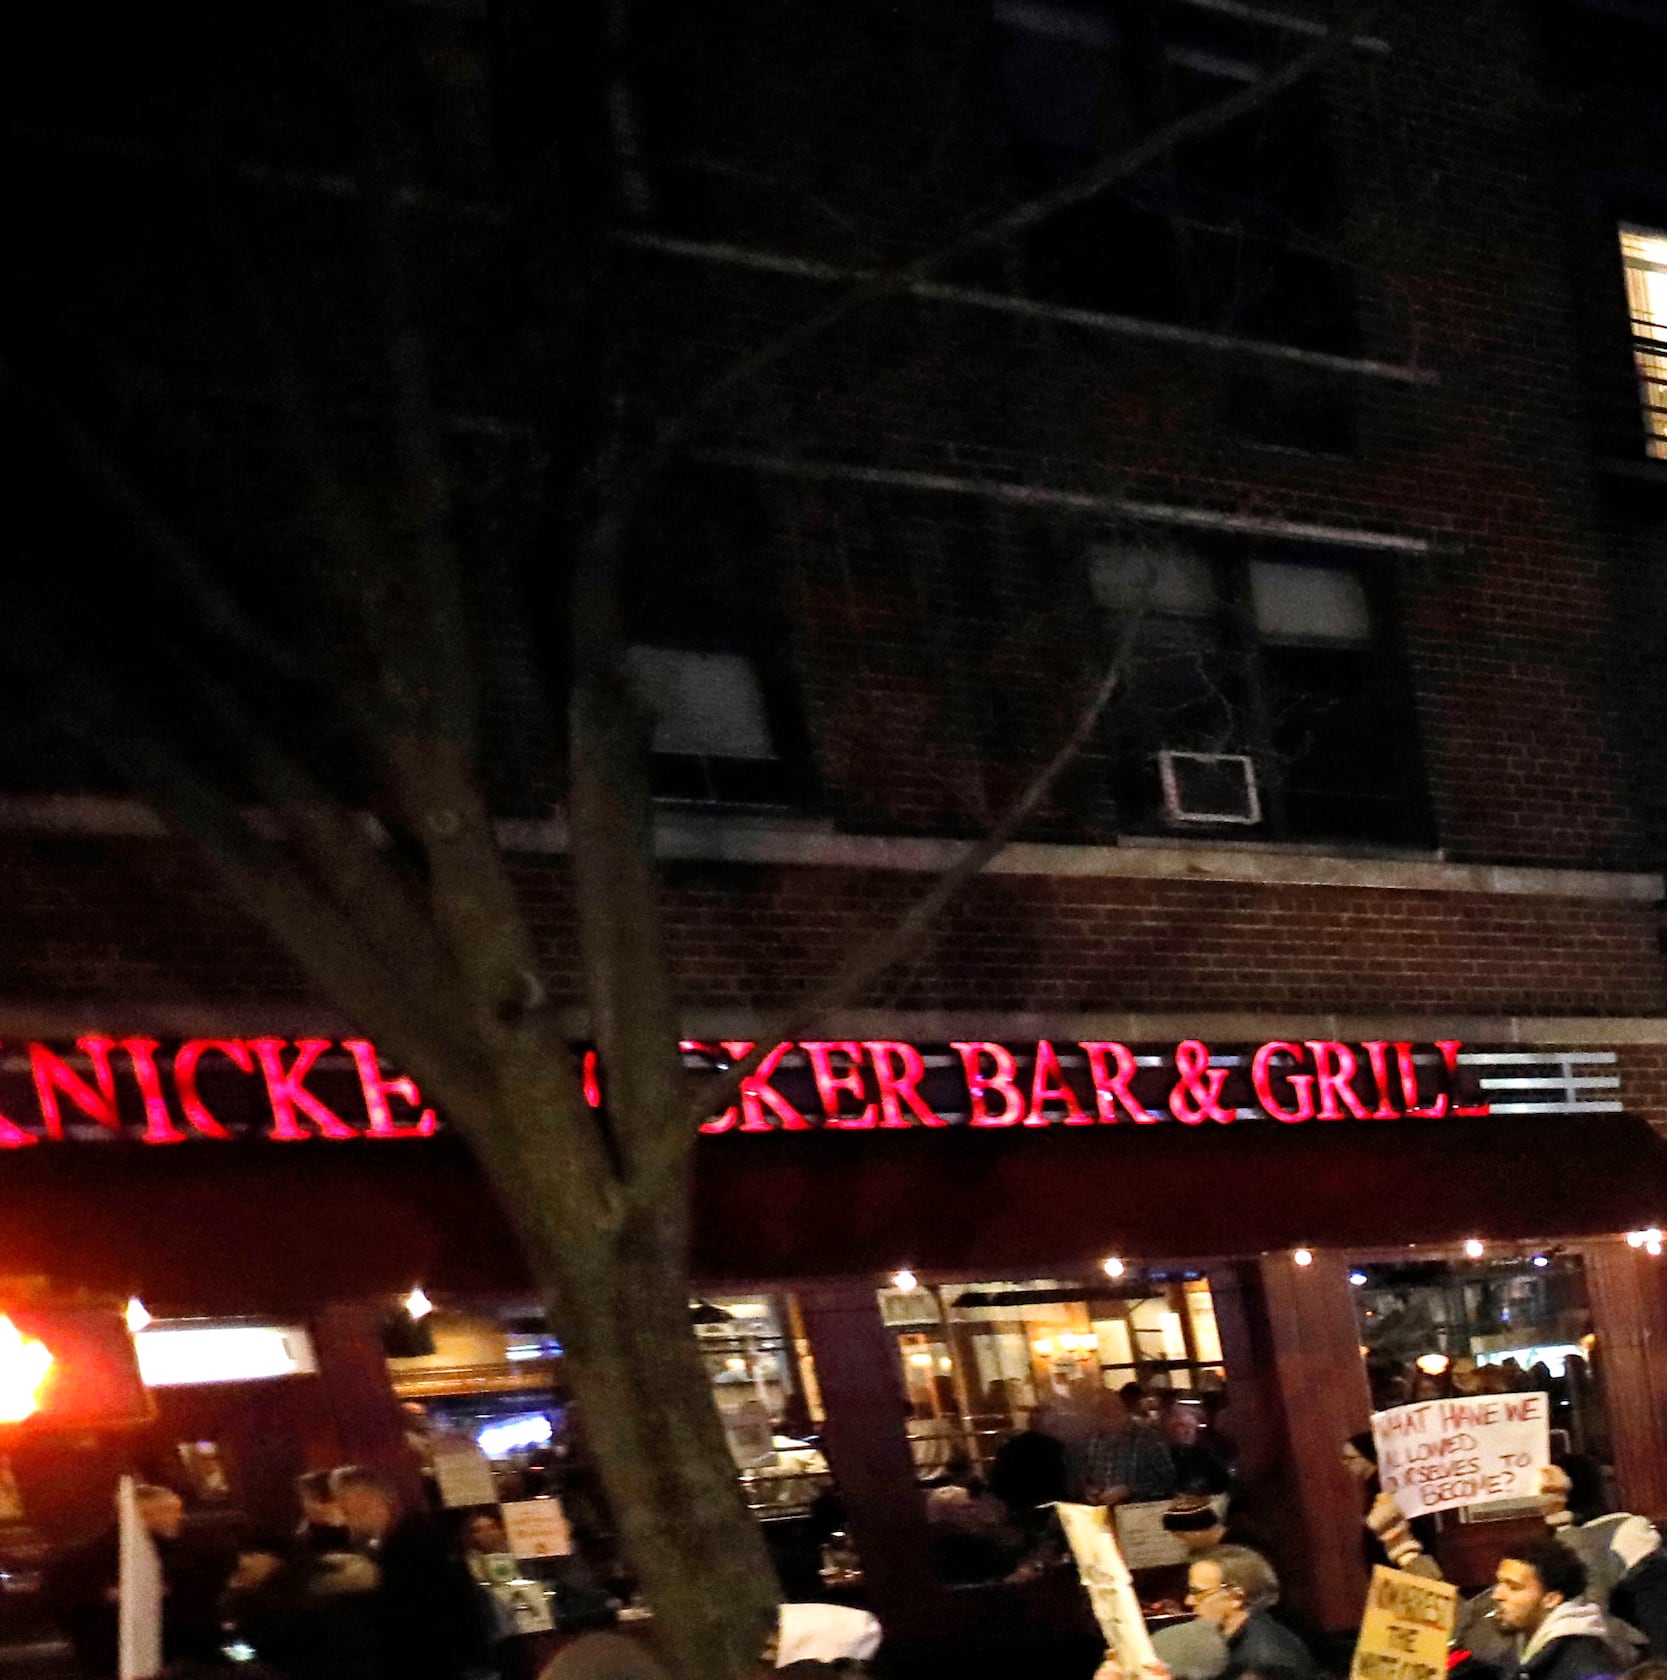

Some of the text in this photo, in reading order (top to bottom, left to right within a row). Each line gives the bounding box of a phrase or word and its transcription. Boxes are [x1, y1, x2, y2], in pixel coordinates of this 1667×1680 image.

[949, 1039, 1158, 1129] BAR
[1169, 1039, 1237, 1126] &
[1438, 1402, 1500, 1433] HAVE
[1504, 1396, 1543, 1423] WE
[1499, 1451, 1533, 1468] TO
[1420, 1469, 1517, 1507] BECOME?
